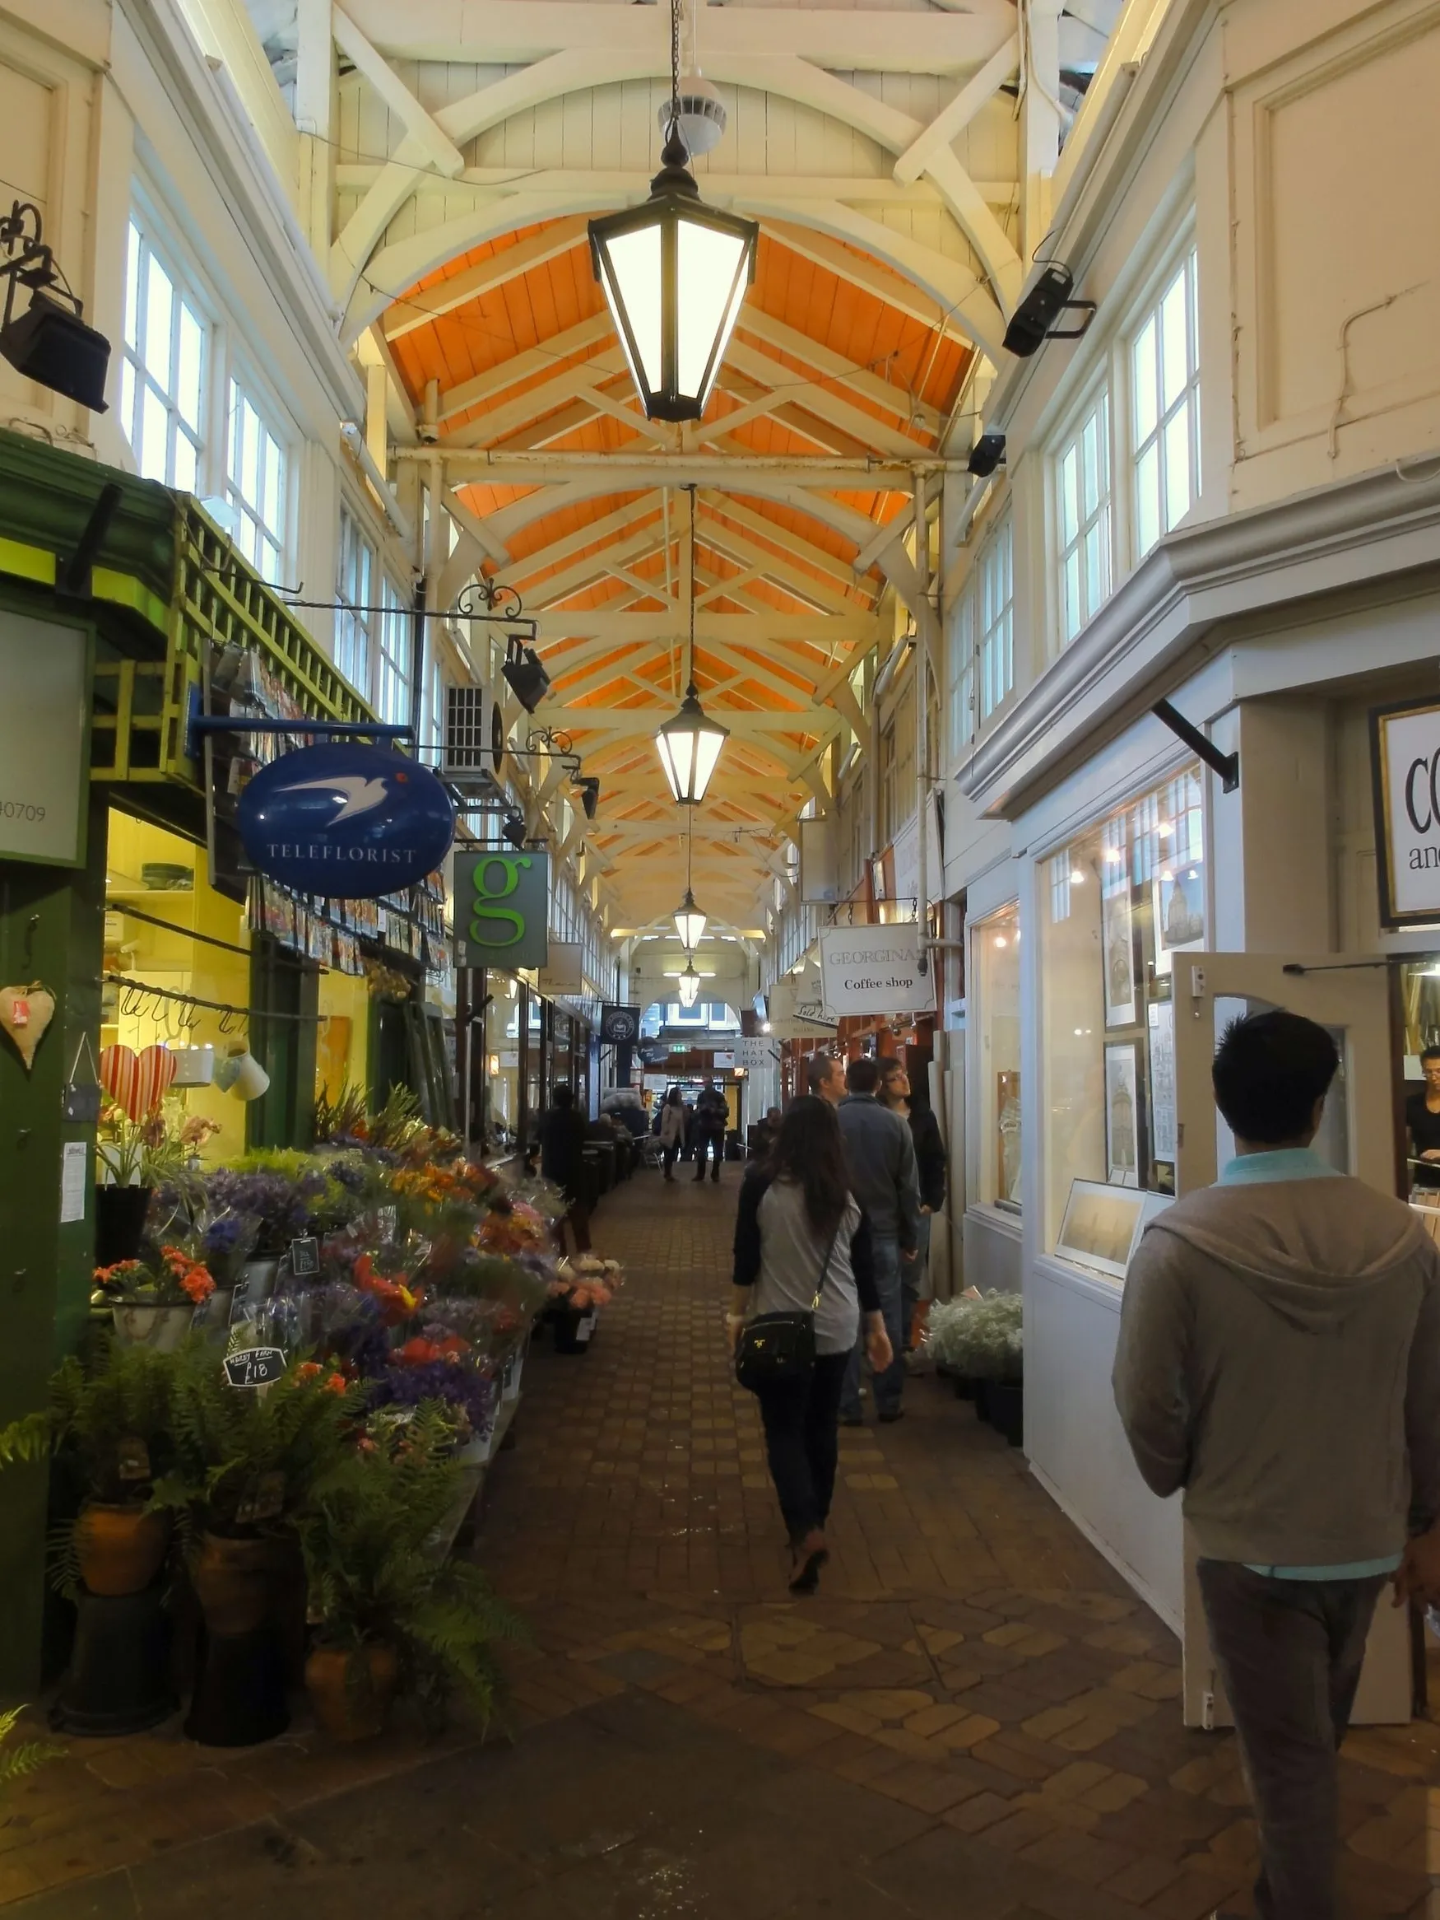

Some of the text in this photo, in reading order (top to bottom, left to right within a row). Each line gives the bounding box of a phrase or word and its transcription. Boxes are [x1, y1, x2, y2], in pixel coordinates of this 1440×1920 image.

[0, 801, 46, 822] 0709
[266, 843, 417, 863] TELEFLORIST
[1409, 846, 1440, 870] an
[469, 856, 532, 947] g
[844, 976, 913, 990] Coffee shop
[244, 1362, 268, 1385] £18
